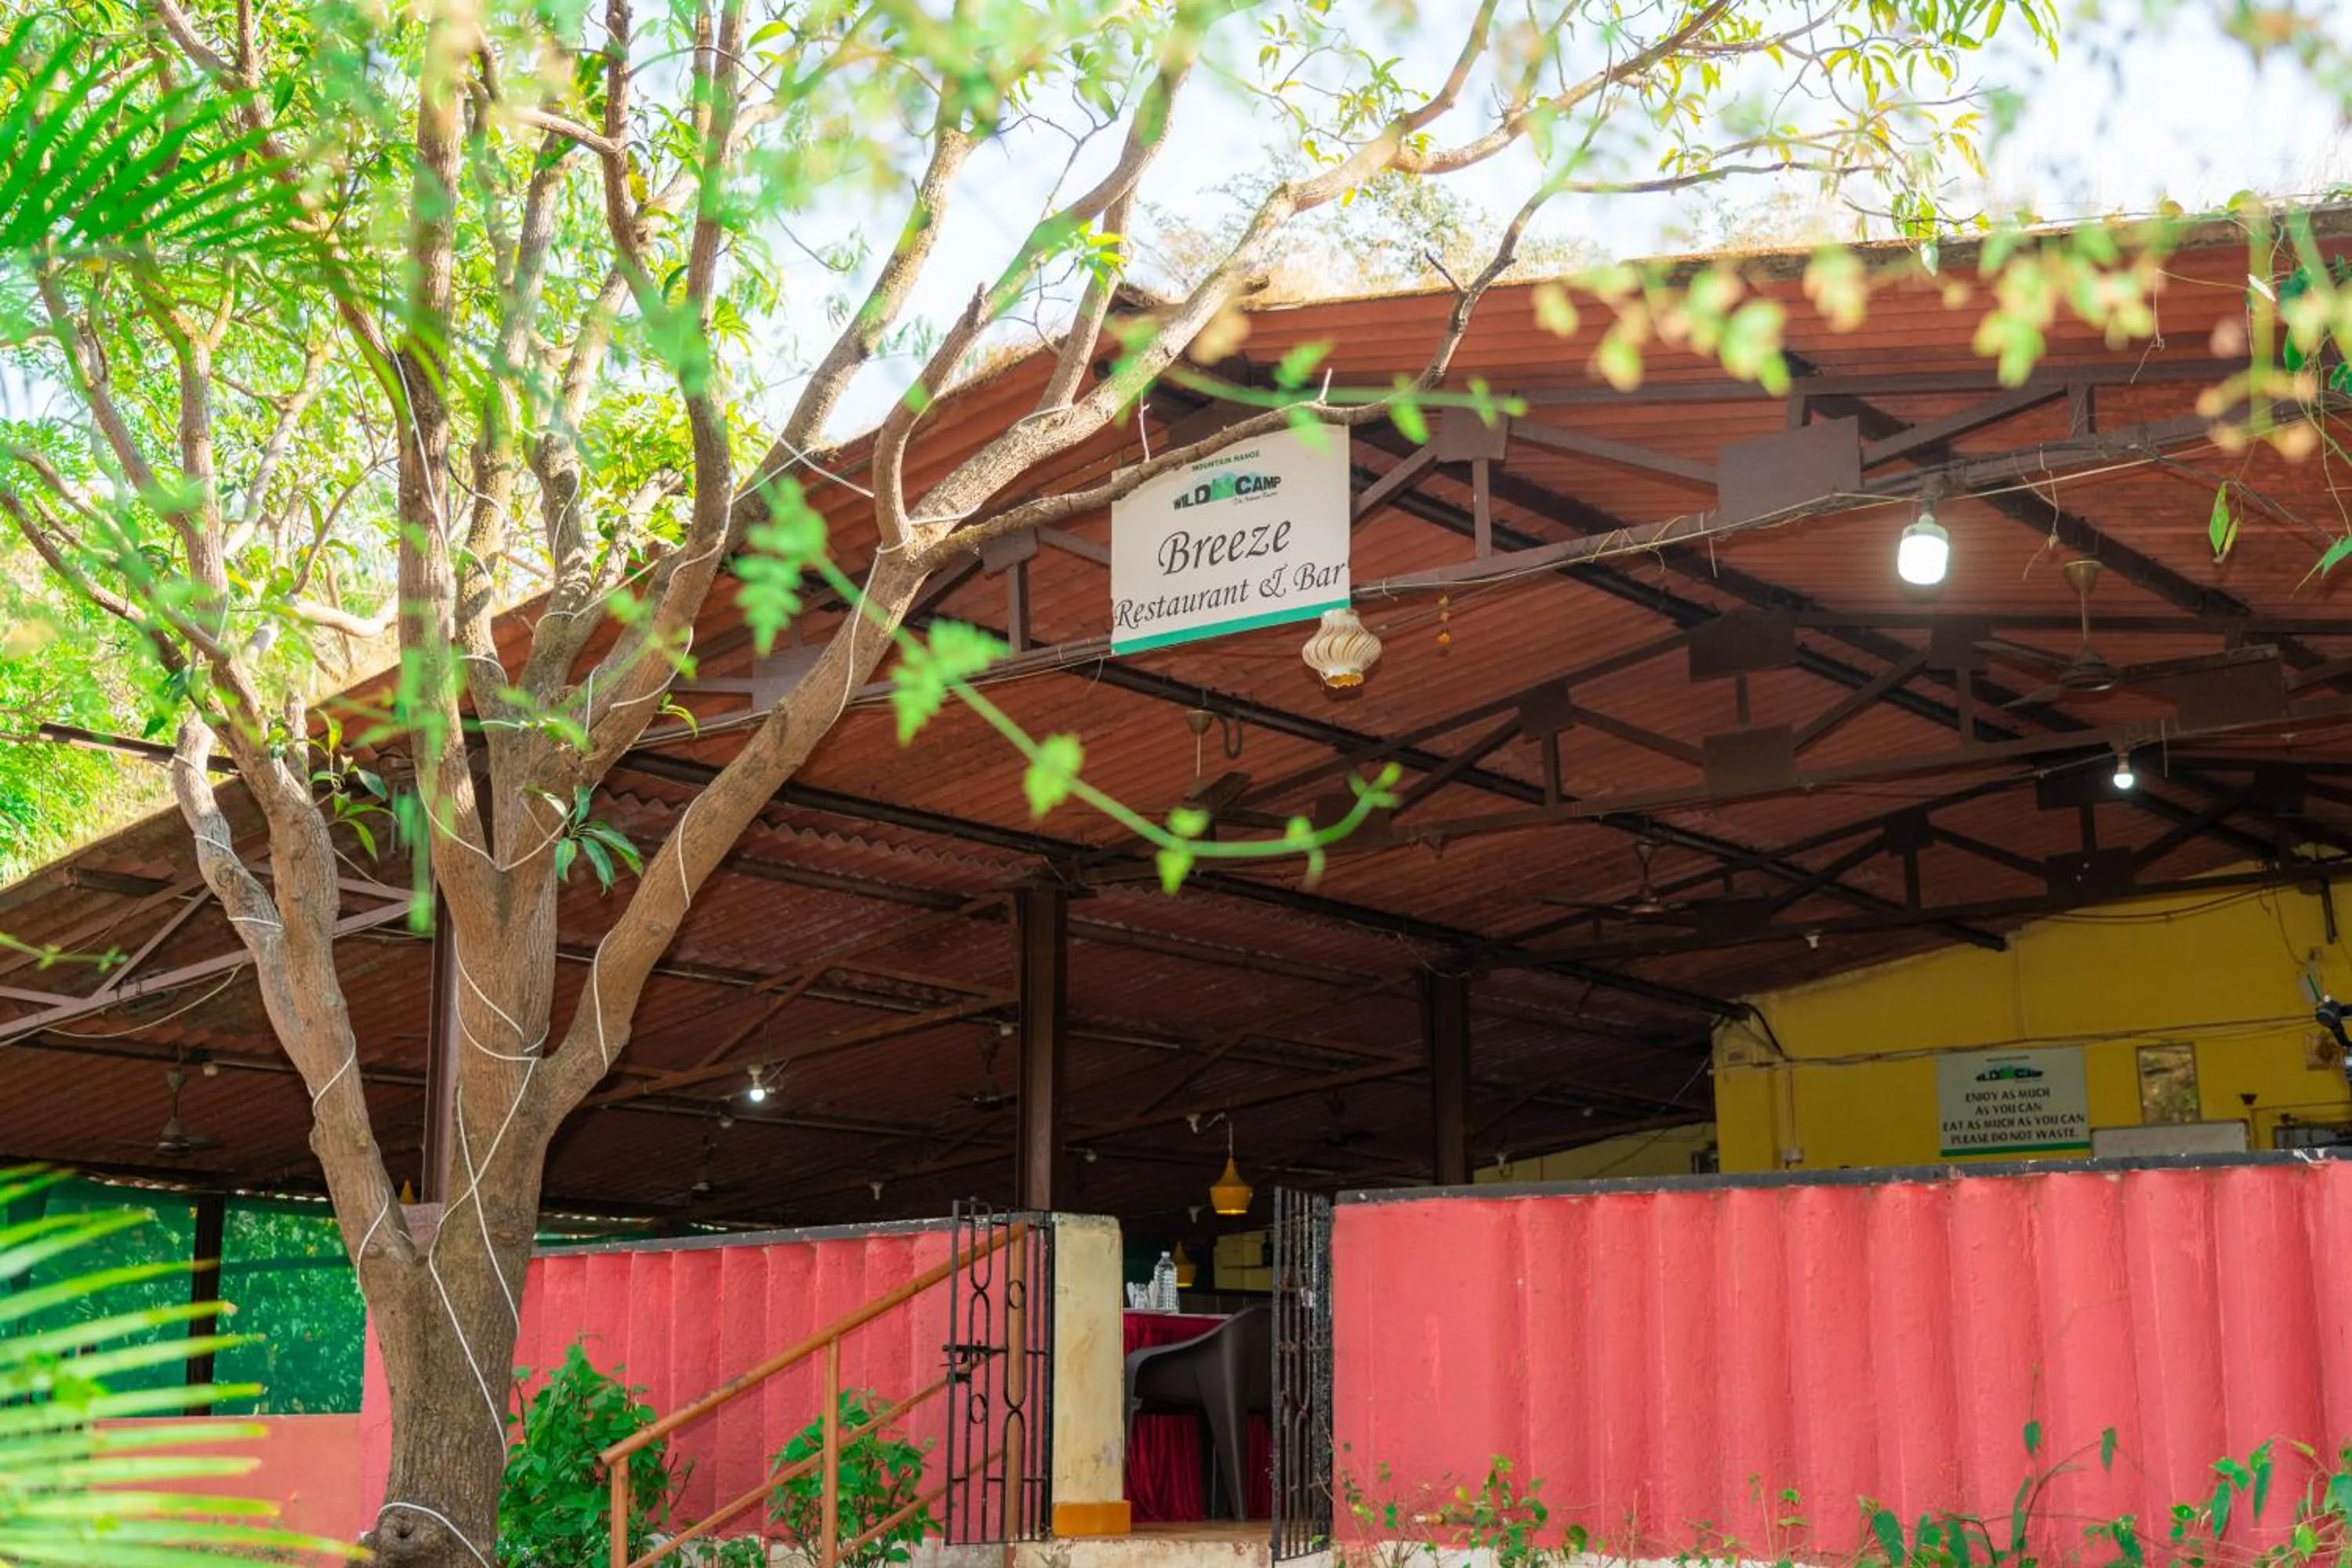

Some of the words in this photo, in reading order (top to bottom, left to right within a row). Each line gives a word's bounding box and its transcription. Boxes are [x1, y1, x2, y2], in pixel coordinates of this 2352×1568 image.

[1236, 476, 1281, 495] CAMP
[1158, 520, 1291, 576] Breeze
[1116, 579, 1249, 630] Restaurant
[1258, 564, 1288, 597] &
[1294, 562, 1345, 592] Bar
[1965, 1091, 1997, 1102] ENJOY
[2002, 1090, 2016, 1100] AS
[2018, 1087, 2050, 1098] MUCH
[1975, 1105, 1989, 1116] AS
[1993, 1104, 2016, 1114] YOU
[2018, 1102, 2042, 1112] CAN
[1943, 1120, 1962, 1131] EAT
[1967, 1120, 1980, 1130] AS
[1984, 1117, 2014, 1128] MUCH
[2017, 1116, 2031, 1127] AS
[2034, 1114, 2058, 1125] YOU
[2060, 1113, 2085, 1123] CAN
[1951, 1133, 1987, 1145] PLEASE
[1991, 1132, 2008, 1142] DO
[2010, 1131, 2032, 1141] NOT
